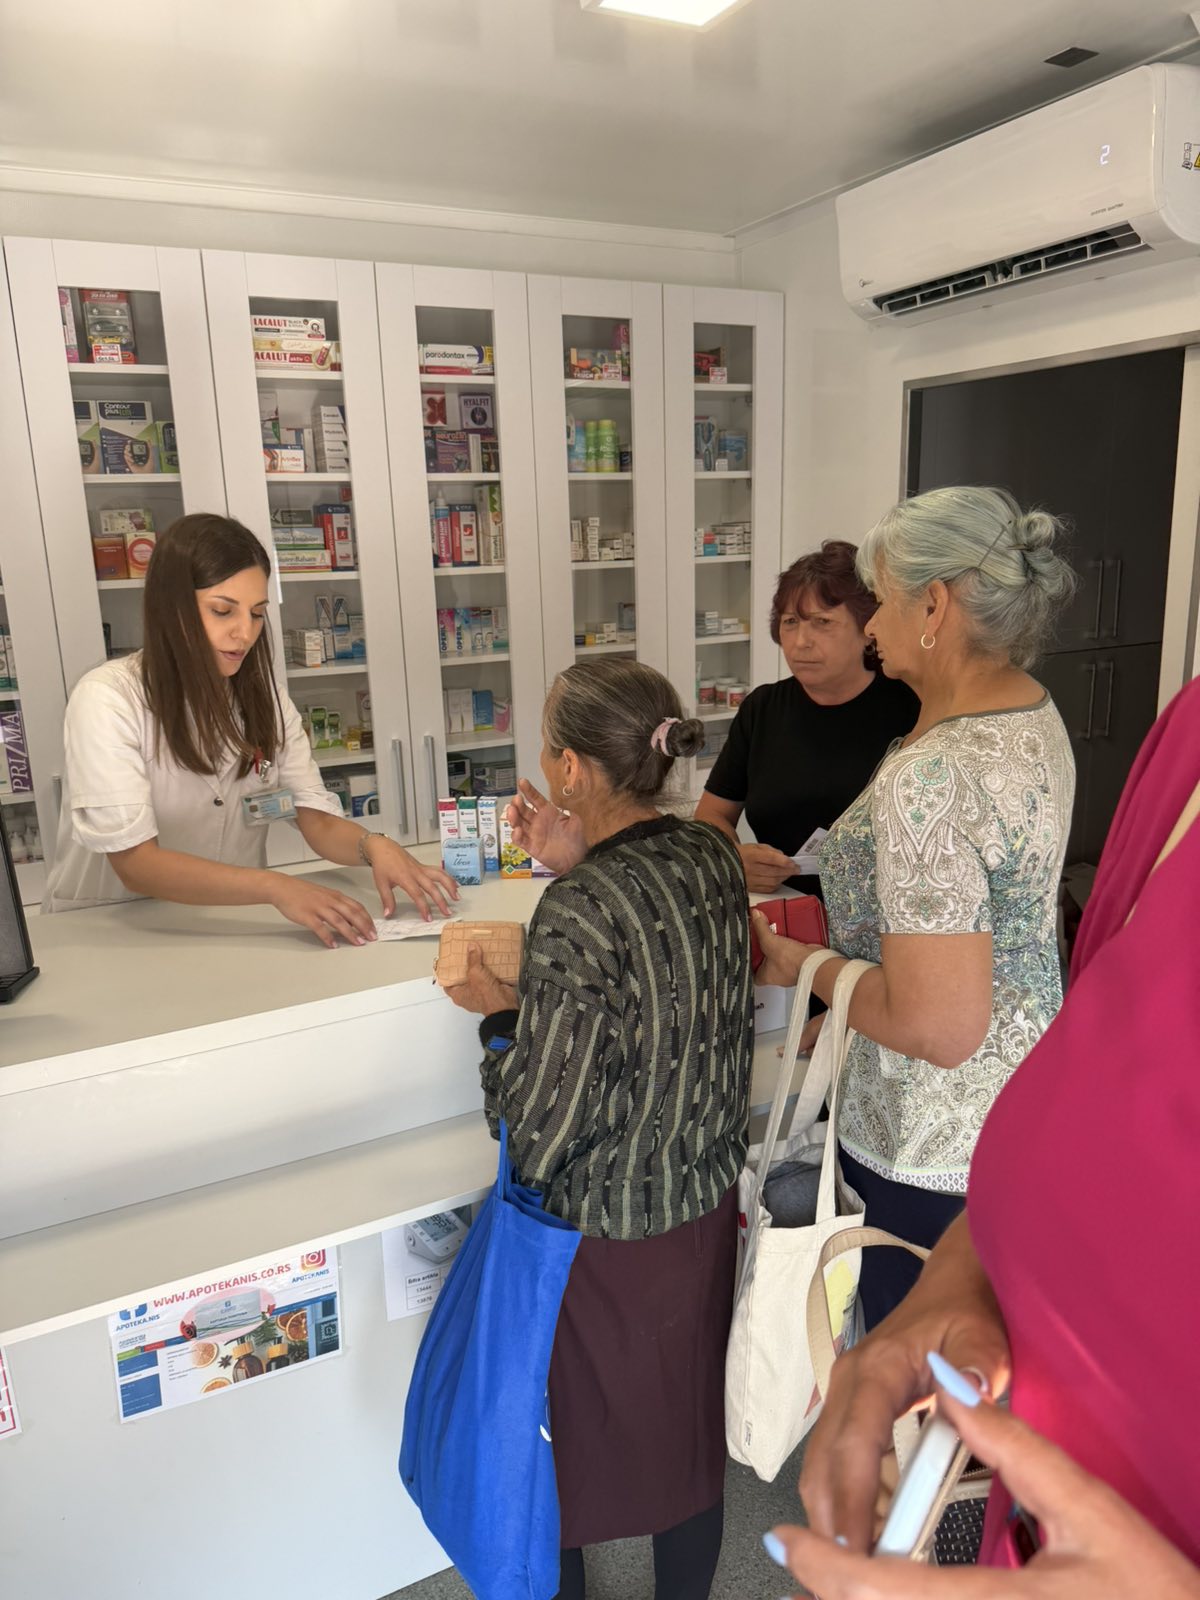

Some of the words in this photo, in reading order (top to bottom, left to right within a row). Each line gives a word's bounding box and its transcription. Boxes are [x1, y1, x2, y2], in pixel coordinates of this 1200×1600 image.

[1100, 144, 1111, 165] 2
[253, 318, 287, 328] LACALUT
[254, 351, 288, 361] ACALUT
[104, 402, 131, 410] Contour
[291, 1268, 330, 1284] APOTEKANIS
[153, 1263, 291, 1309] WWW.APOTEKANIS.CO.RS
[115, 1313, 161, 1332] APOTEKA.NIS
